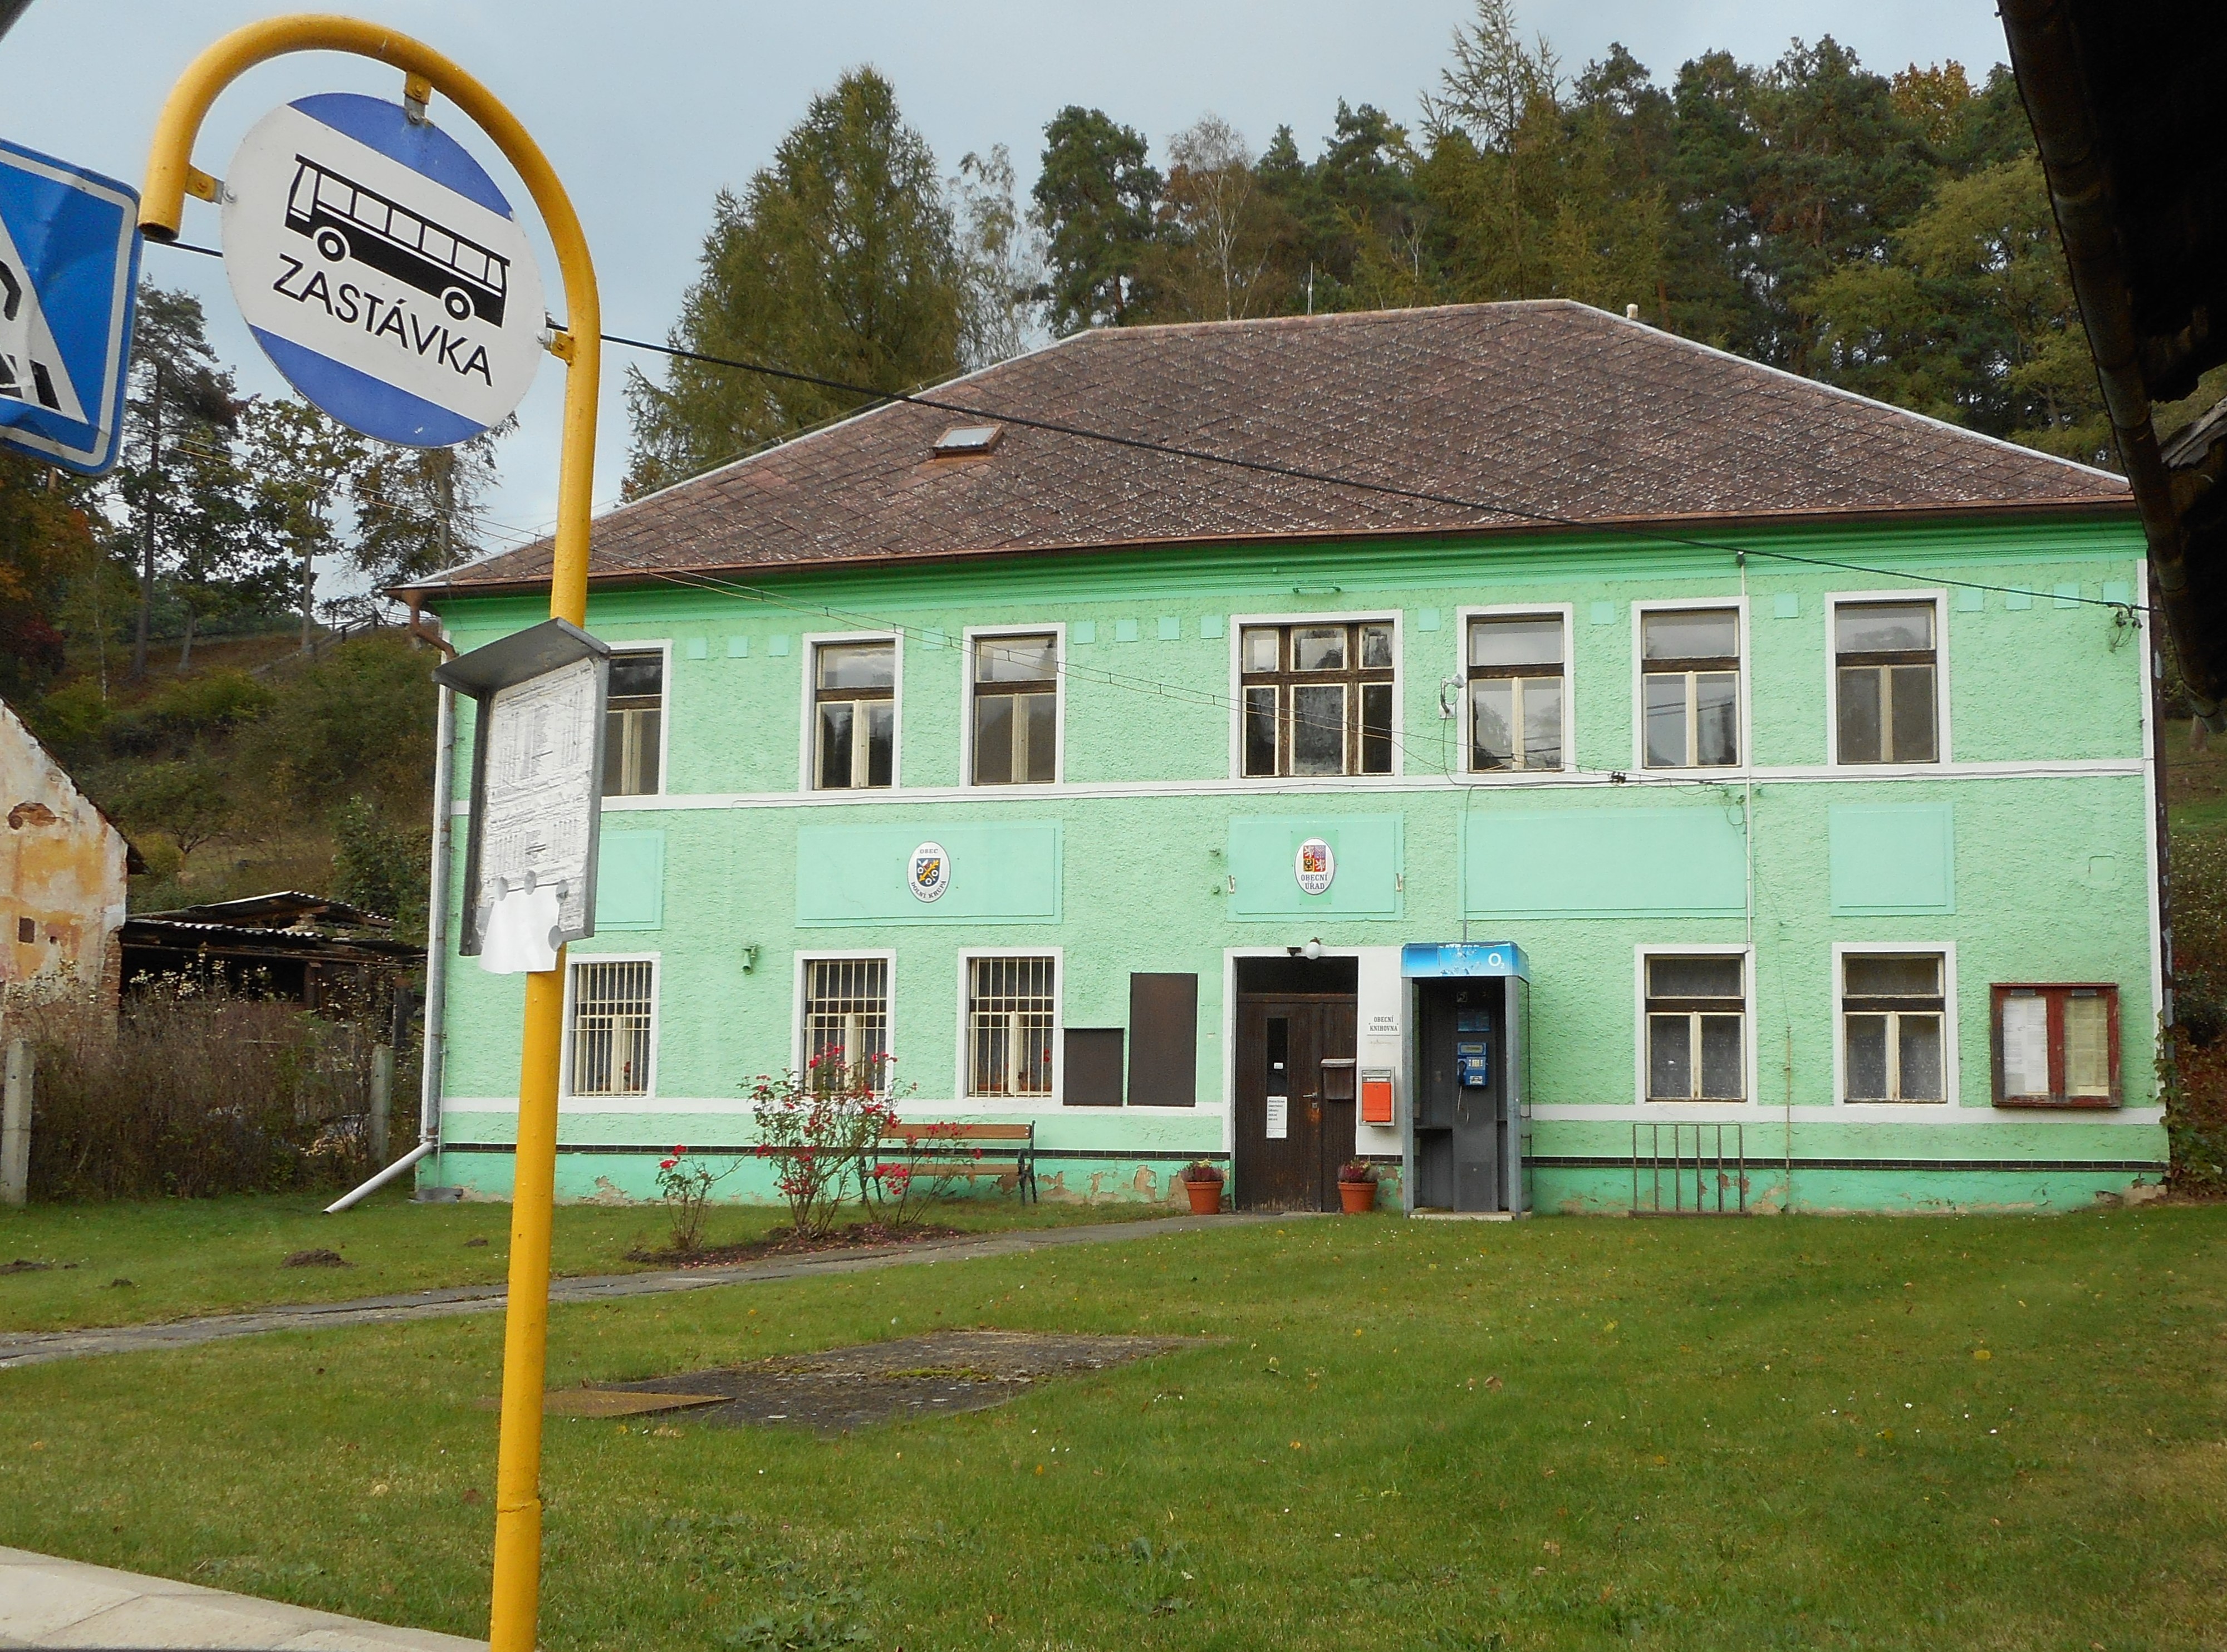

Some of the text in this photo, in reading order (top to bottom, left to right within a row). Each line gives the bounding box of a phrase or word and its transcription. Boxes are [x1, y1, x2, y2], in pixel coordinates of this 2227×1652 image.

[273, 253, 493, 388] ZASTÁVKA
[1301, 872, 1328, 881] OBECNÍ
[1305, 881, 1325, 889] ÚŘAD
